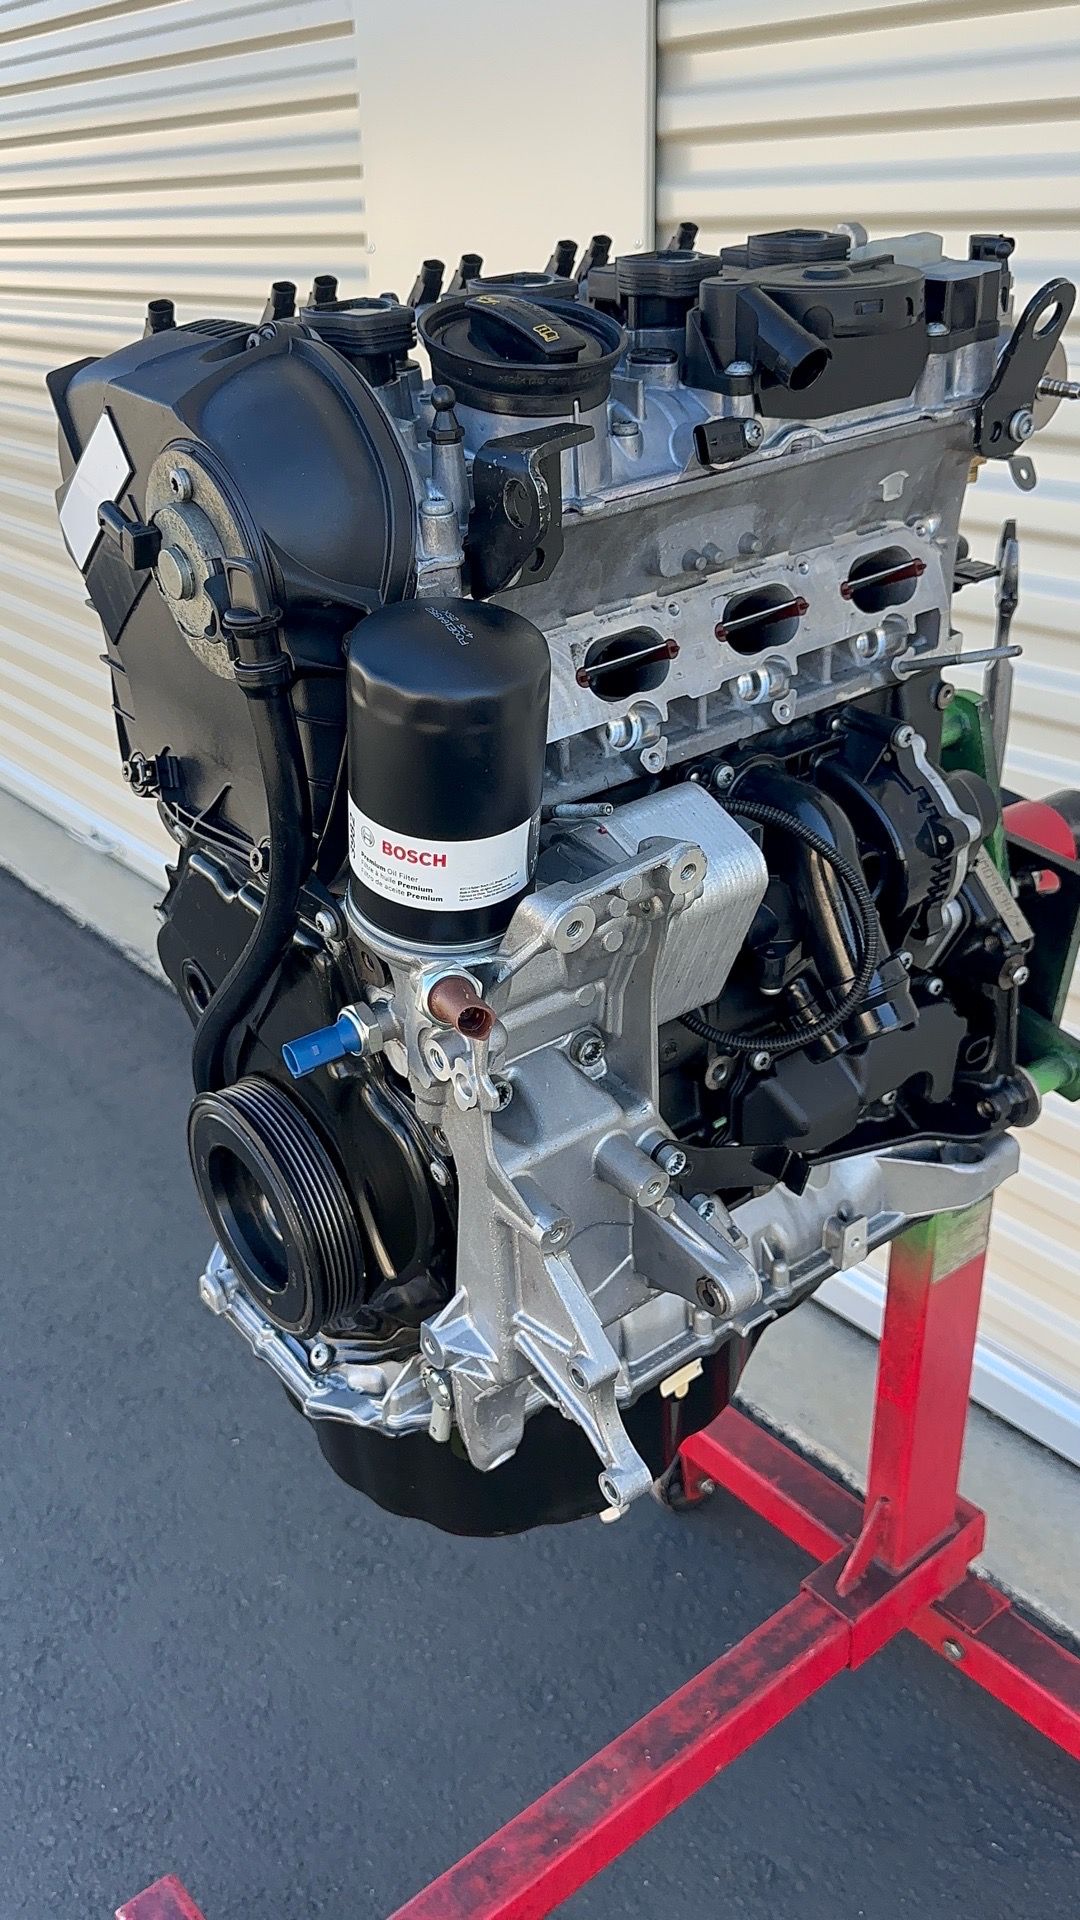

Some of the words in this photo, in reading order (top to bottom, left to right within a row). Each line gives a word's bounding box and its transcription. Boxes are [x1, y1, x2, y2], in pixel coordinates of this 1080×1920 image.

[382, 840, 447, 867] BOSCH
[361, 851, 386, 873] Premium
[387, 868, 397, 877] Oil
[398, 872, 419, 883] Filter
[375, 879, 384, 888] de
[384, 884, 406, 896] aceite
[406, 891, 444, 902] Premium
[380, 872, 396, 884] huile
[397, 881, 434, 893] Premium
